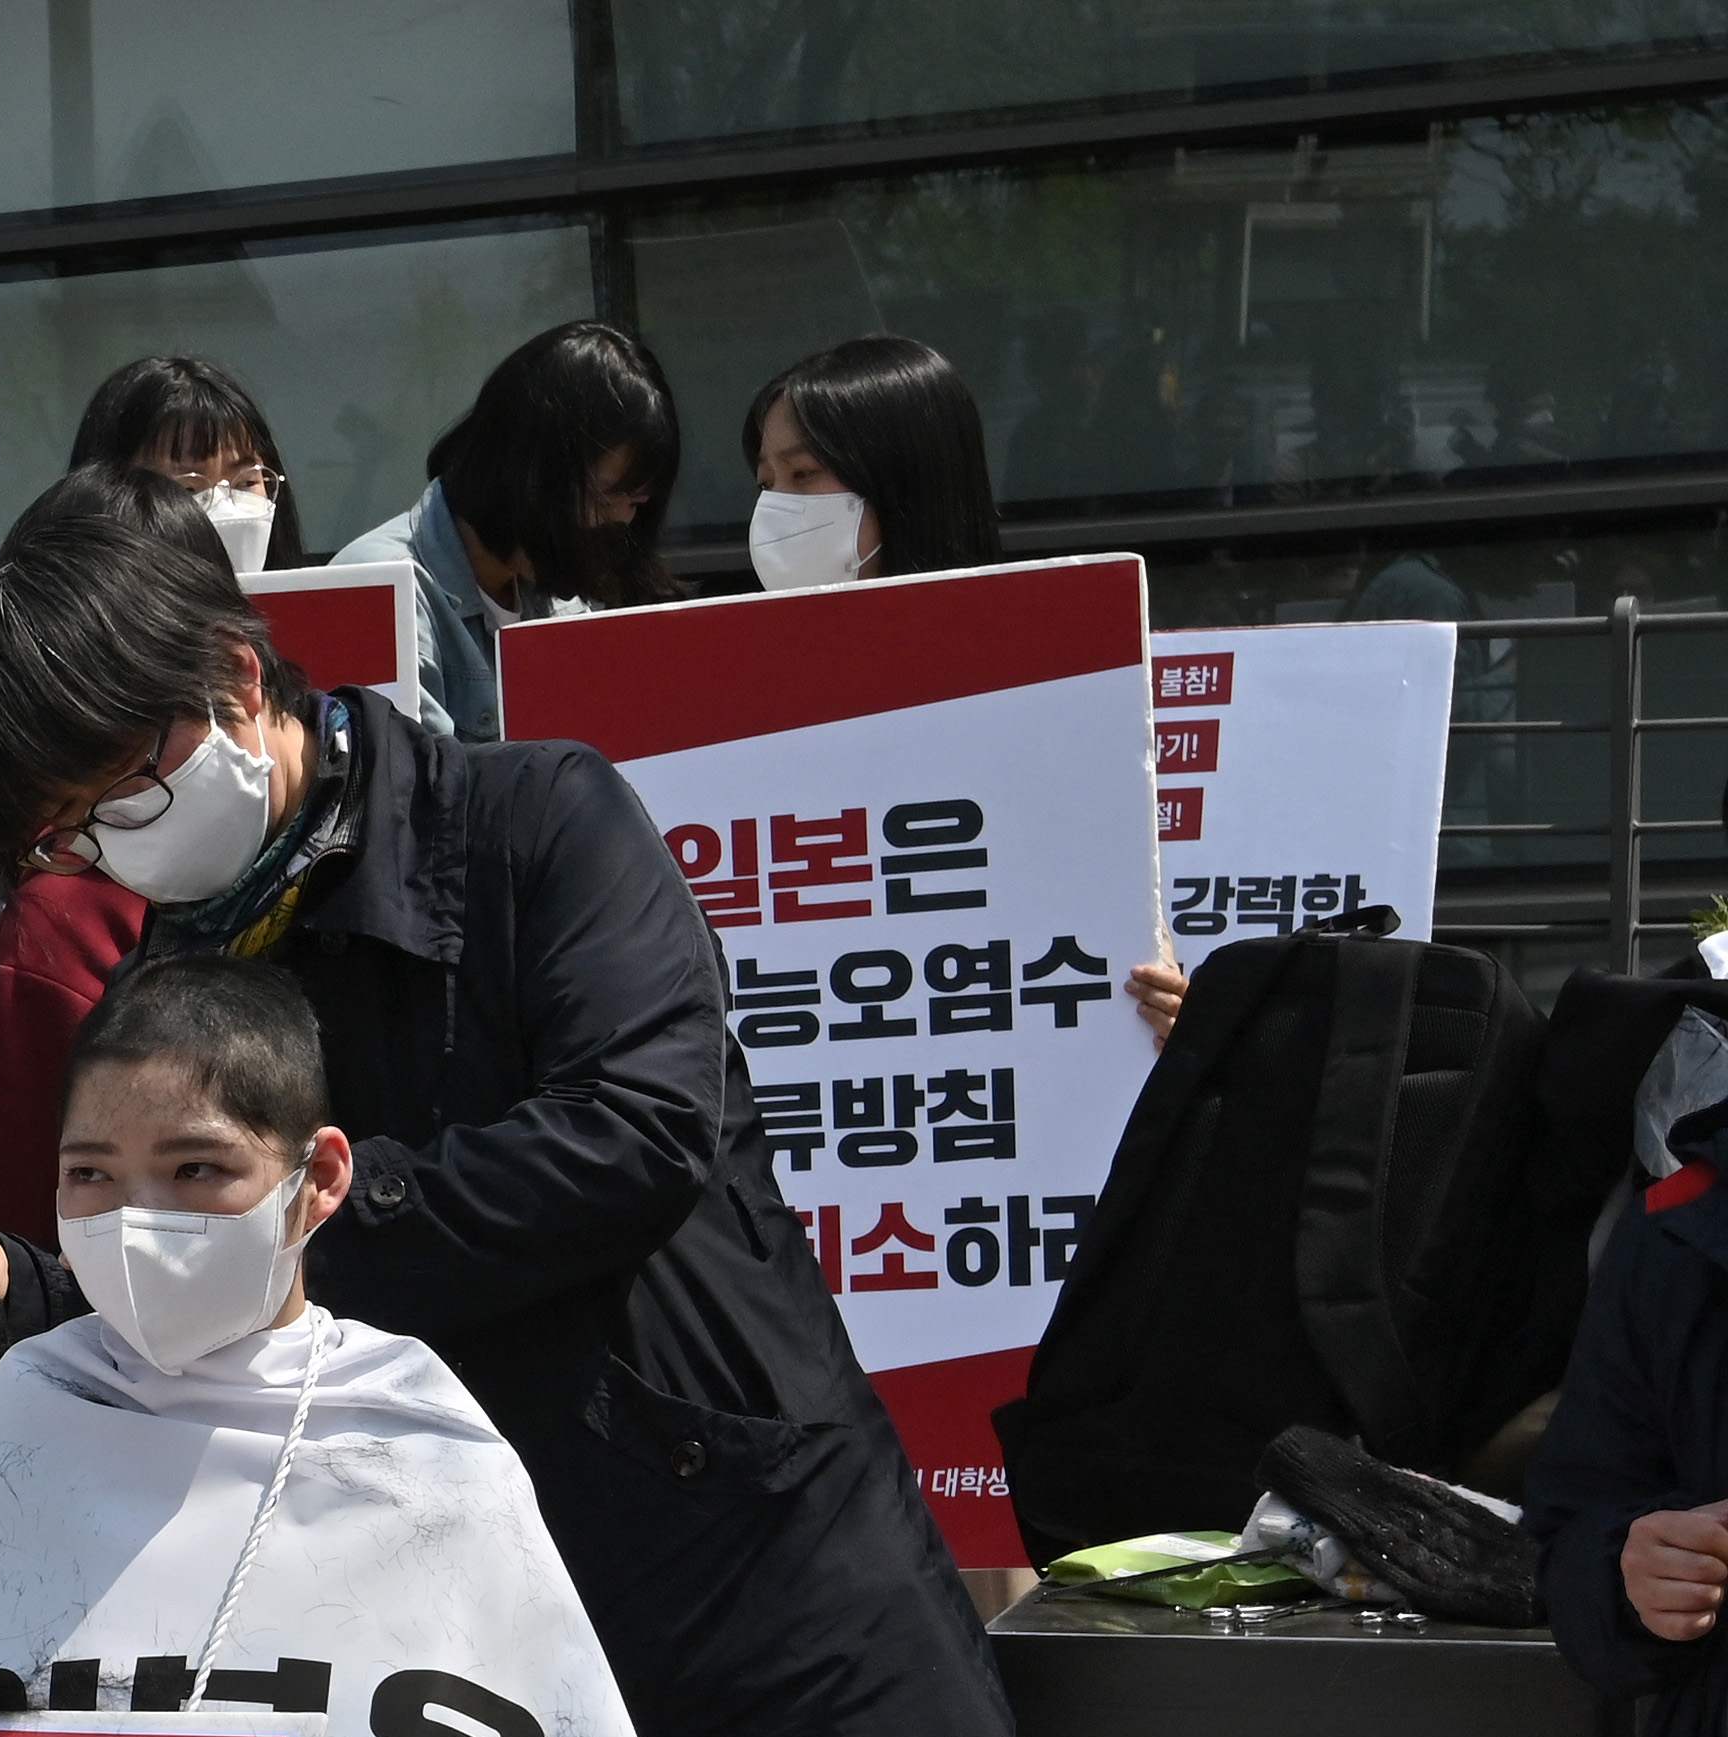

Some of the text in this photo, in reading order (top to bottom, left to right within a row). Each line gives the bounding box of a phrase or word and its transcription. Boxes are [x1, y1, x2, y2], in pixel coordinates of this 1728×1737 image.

[1159, 666, 1218, 697] 불참!
[662, 798, 988, 928] 일본은
[1170, 873, 1367, 936] 강력한
[725, 934, 1112, 1049] 능오염수
